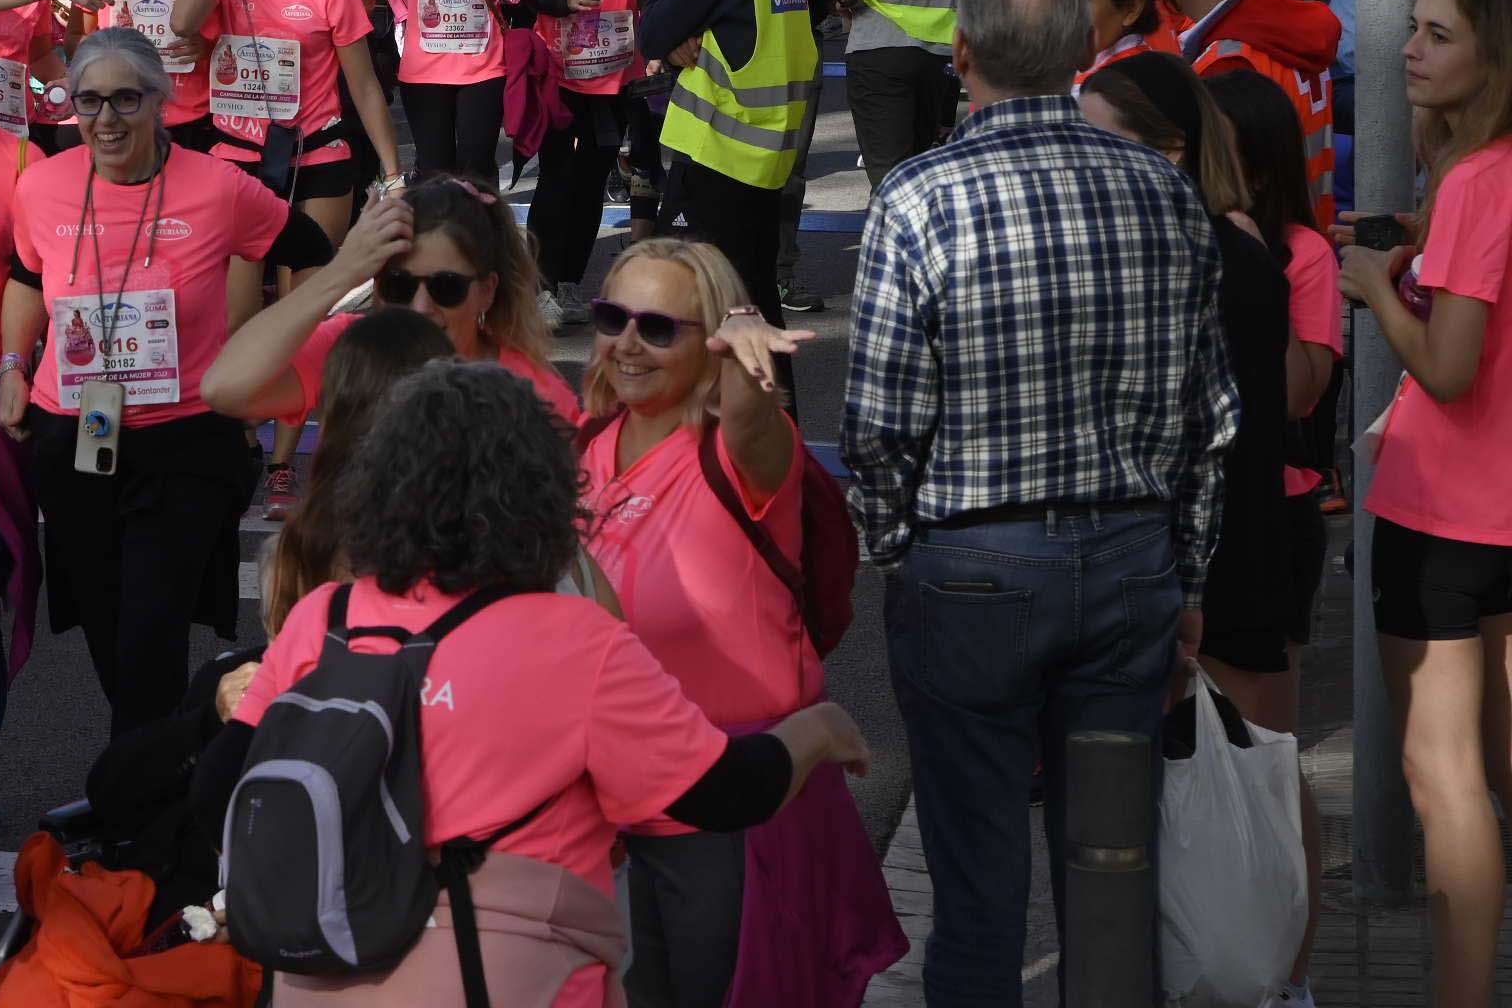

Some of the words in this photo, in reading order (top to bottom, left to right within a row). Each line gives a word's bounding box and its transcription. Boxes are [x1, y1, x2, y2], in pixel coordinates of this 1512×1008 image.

[442, 12, 468, 23] 016
[137, 23, 166, 35] 016
[240, 68, 271, 81] 016
[218, 113, 265, 138] SUM
[55, 223, 105, 237] OYSHO
[144, 304, 168, 313] SUMA
[98, 336, 139, 354] 016
[103, 357, 136, 370] 20182
[118, 373, 129, 381] LA
[137, 385, 171, 396] Santander
[419, 677, 455, 710] RA
